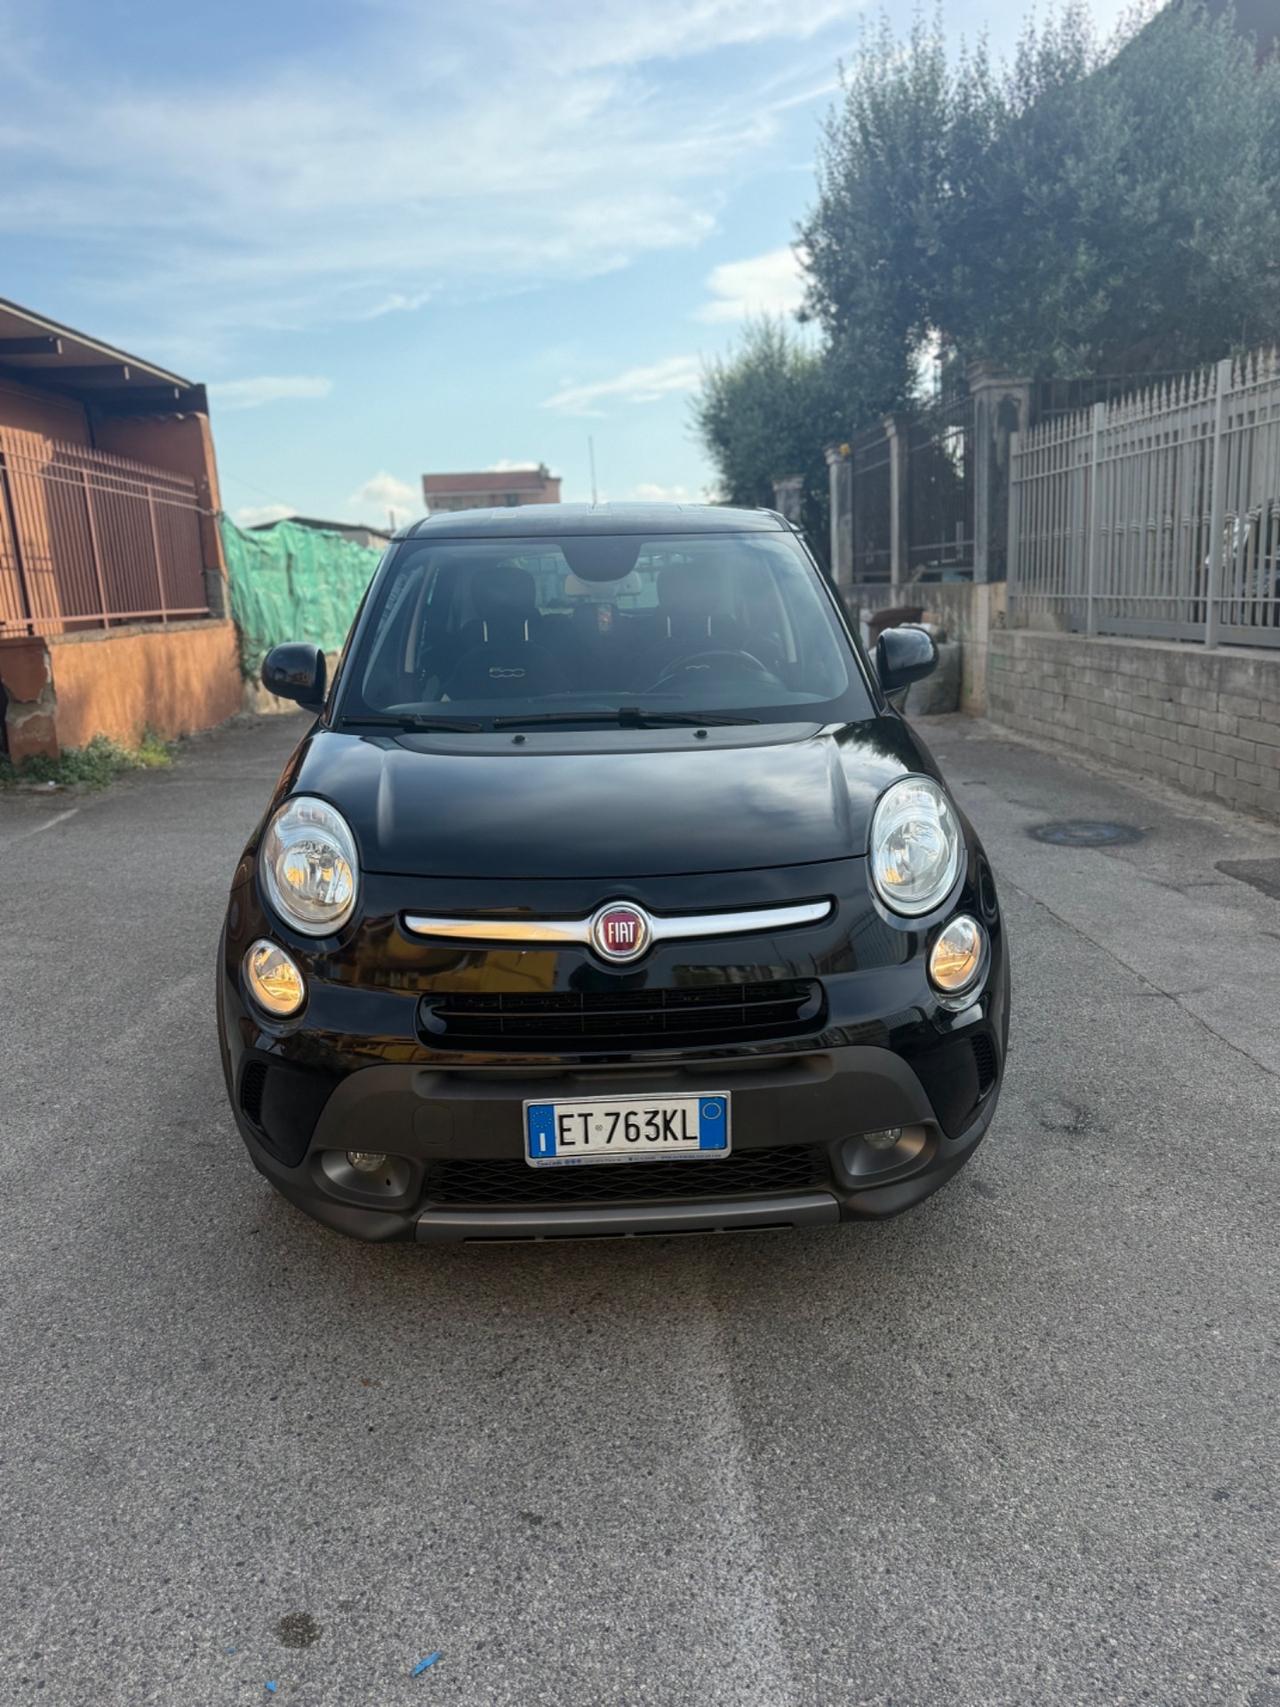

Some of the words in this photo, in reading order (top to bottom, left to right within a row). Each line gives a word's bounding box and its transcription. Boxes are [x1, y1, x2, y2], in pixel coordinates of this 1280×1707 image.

[607, 920, 636, 944] FIAT
[558, 1112, 594, 1146] ET
[604, 1108, 698, 1145] 763KL
